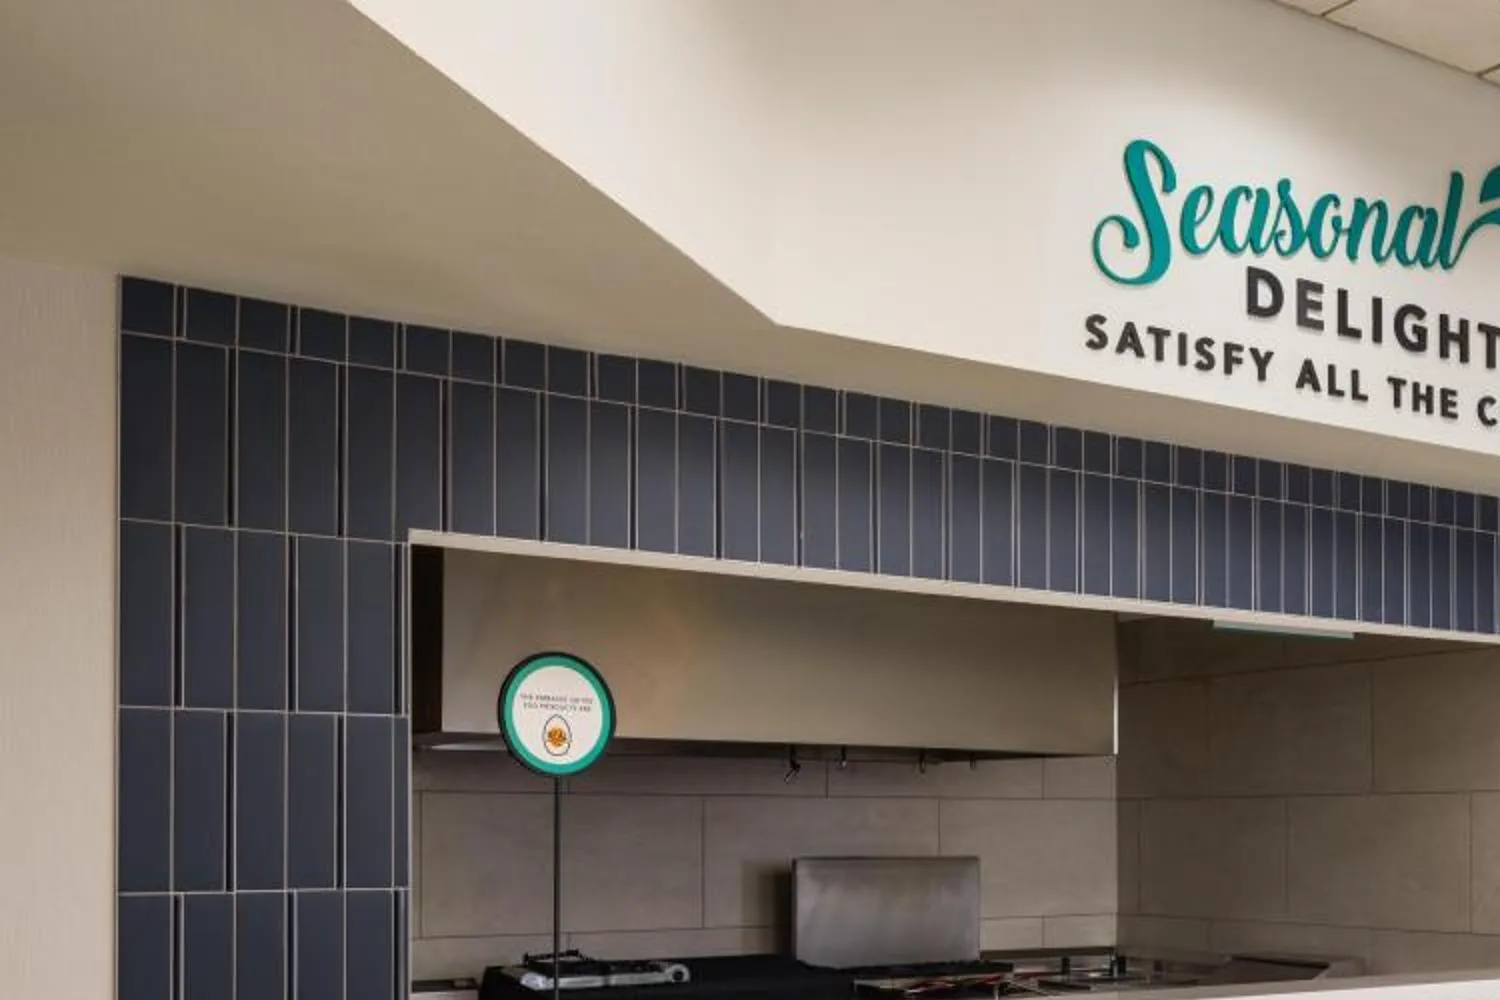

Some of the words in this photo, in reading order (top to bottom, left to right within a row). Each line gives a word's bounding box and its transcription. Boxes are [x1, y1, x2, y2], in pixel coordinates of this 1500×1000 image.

[1092, 138, 1472, 287] Seasonal
[1085, 314, 1275, 382] SATISFY
[1295, 359, 1370, 402] ALL
[1387, 376, 1459, 420] THE
